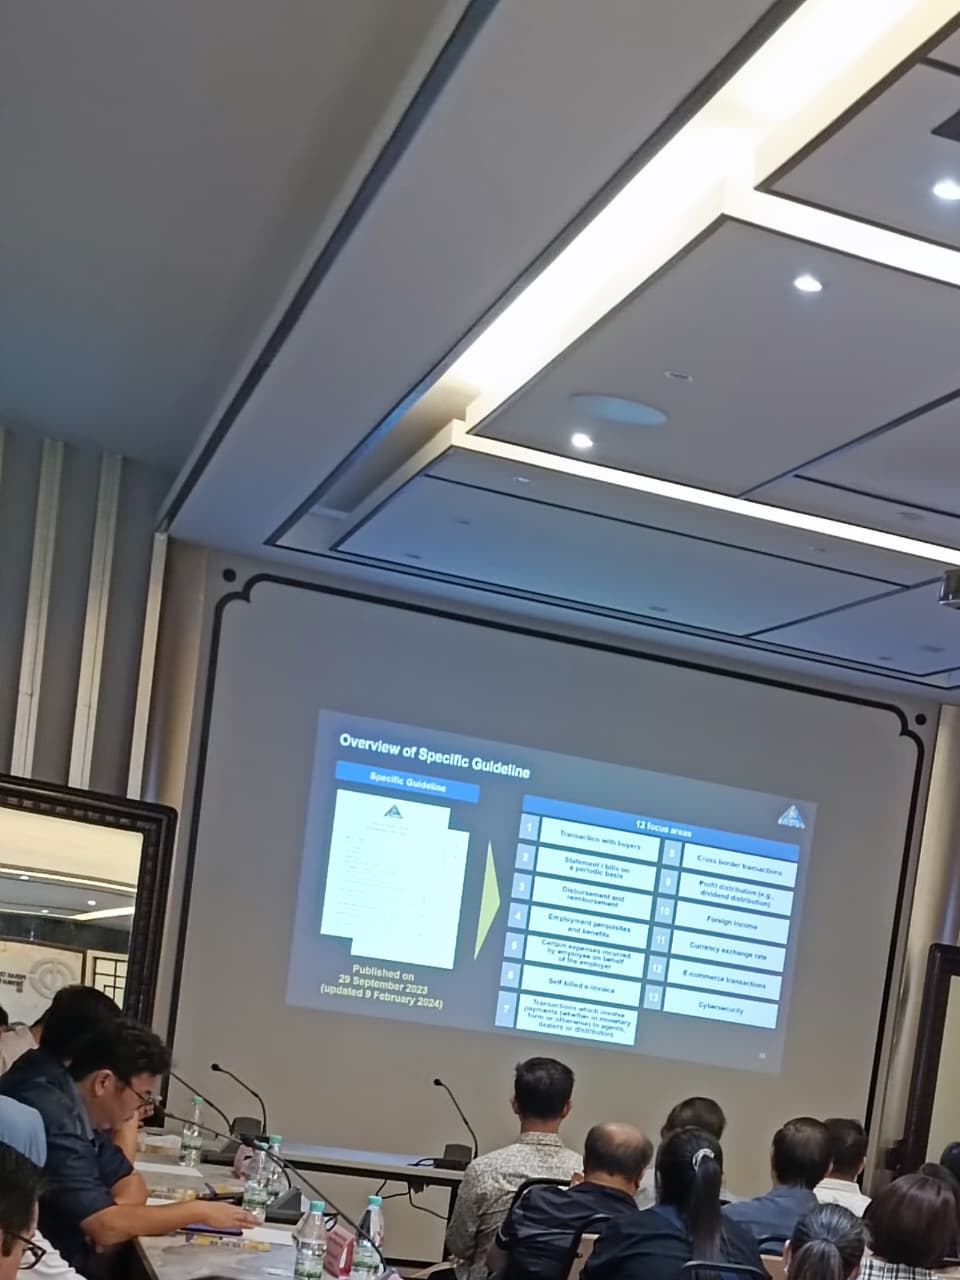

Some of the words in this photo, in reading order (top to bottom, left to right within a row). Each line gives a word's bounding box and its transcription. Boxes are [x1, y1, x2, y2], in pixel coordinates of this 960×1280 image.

[339, 732, 401, 756] Overview
[402, 746, 417, 759] of
[418, 747, 469, 768] Specific
[471, 757, 531, 779] Guideline
[369, 771, 404, 786] Specific
[405, 778, 447, 793] Guideline
[352, 964, 401, 980] Published
[402, 972, 415, 982] on
[338, 974, 351, 984] 29
[352, 976, 404, 992] September
[405, 984, 428, 995] 2023
[320, 983, 363, 998] (updated
[373, 991, 416, 1007] February
[417, 997, 443, 1010] 2024)
